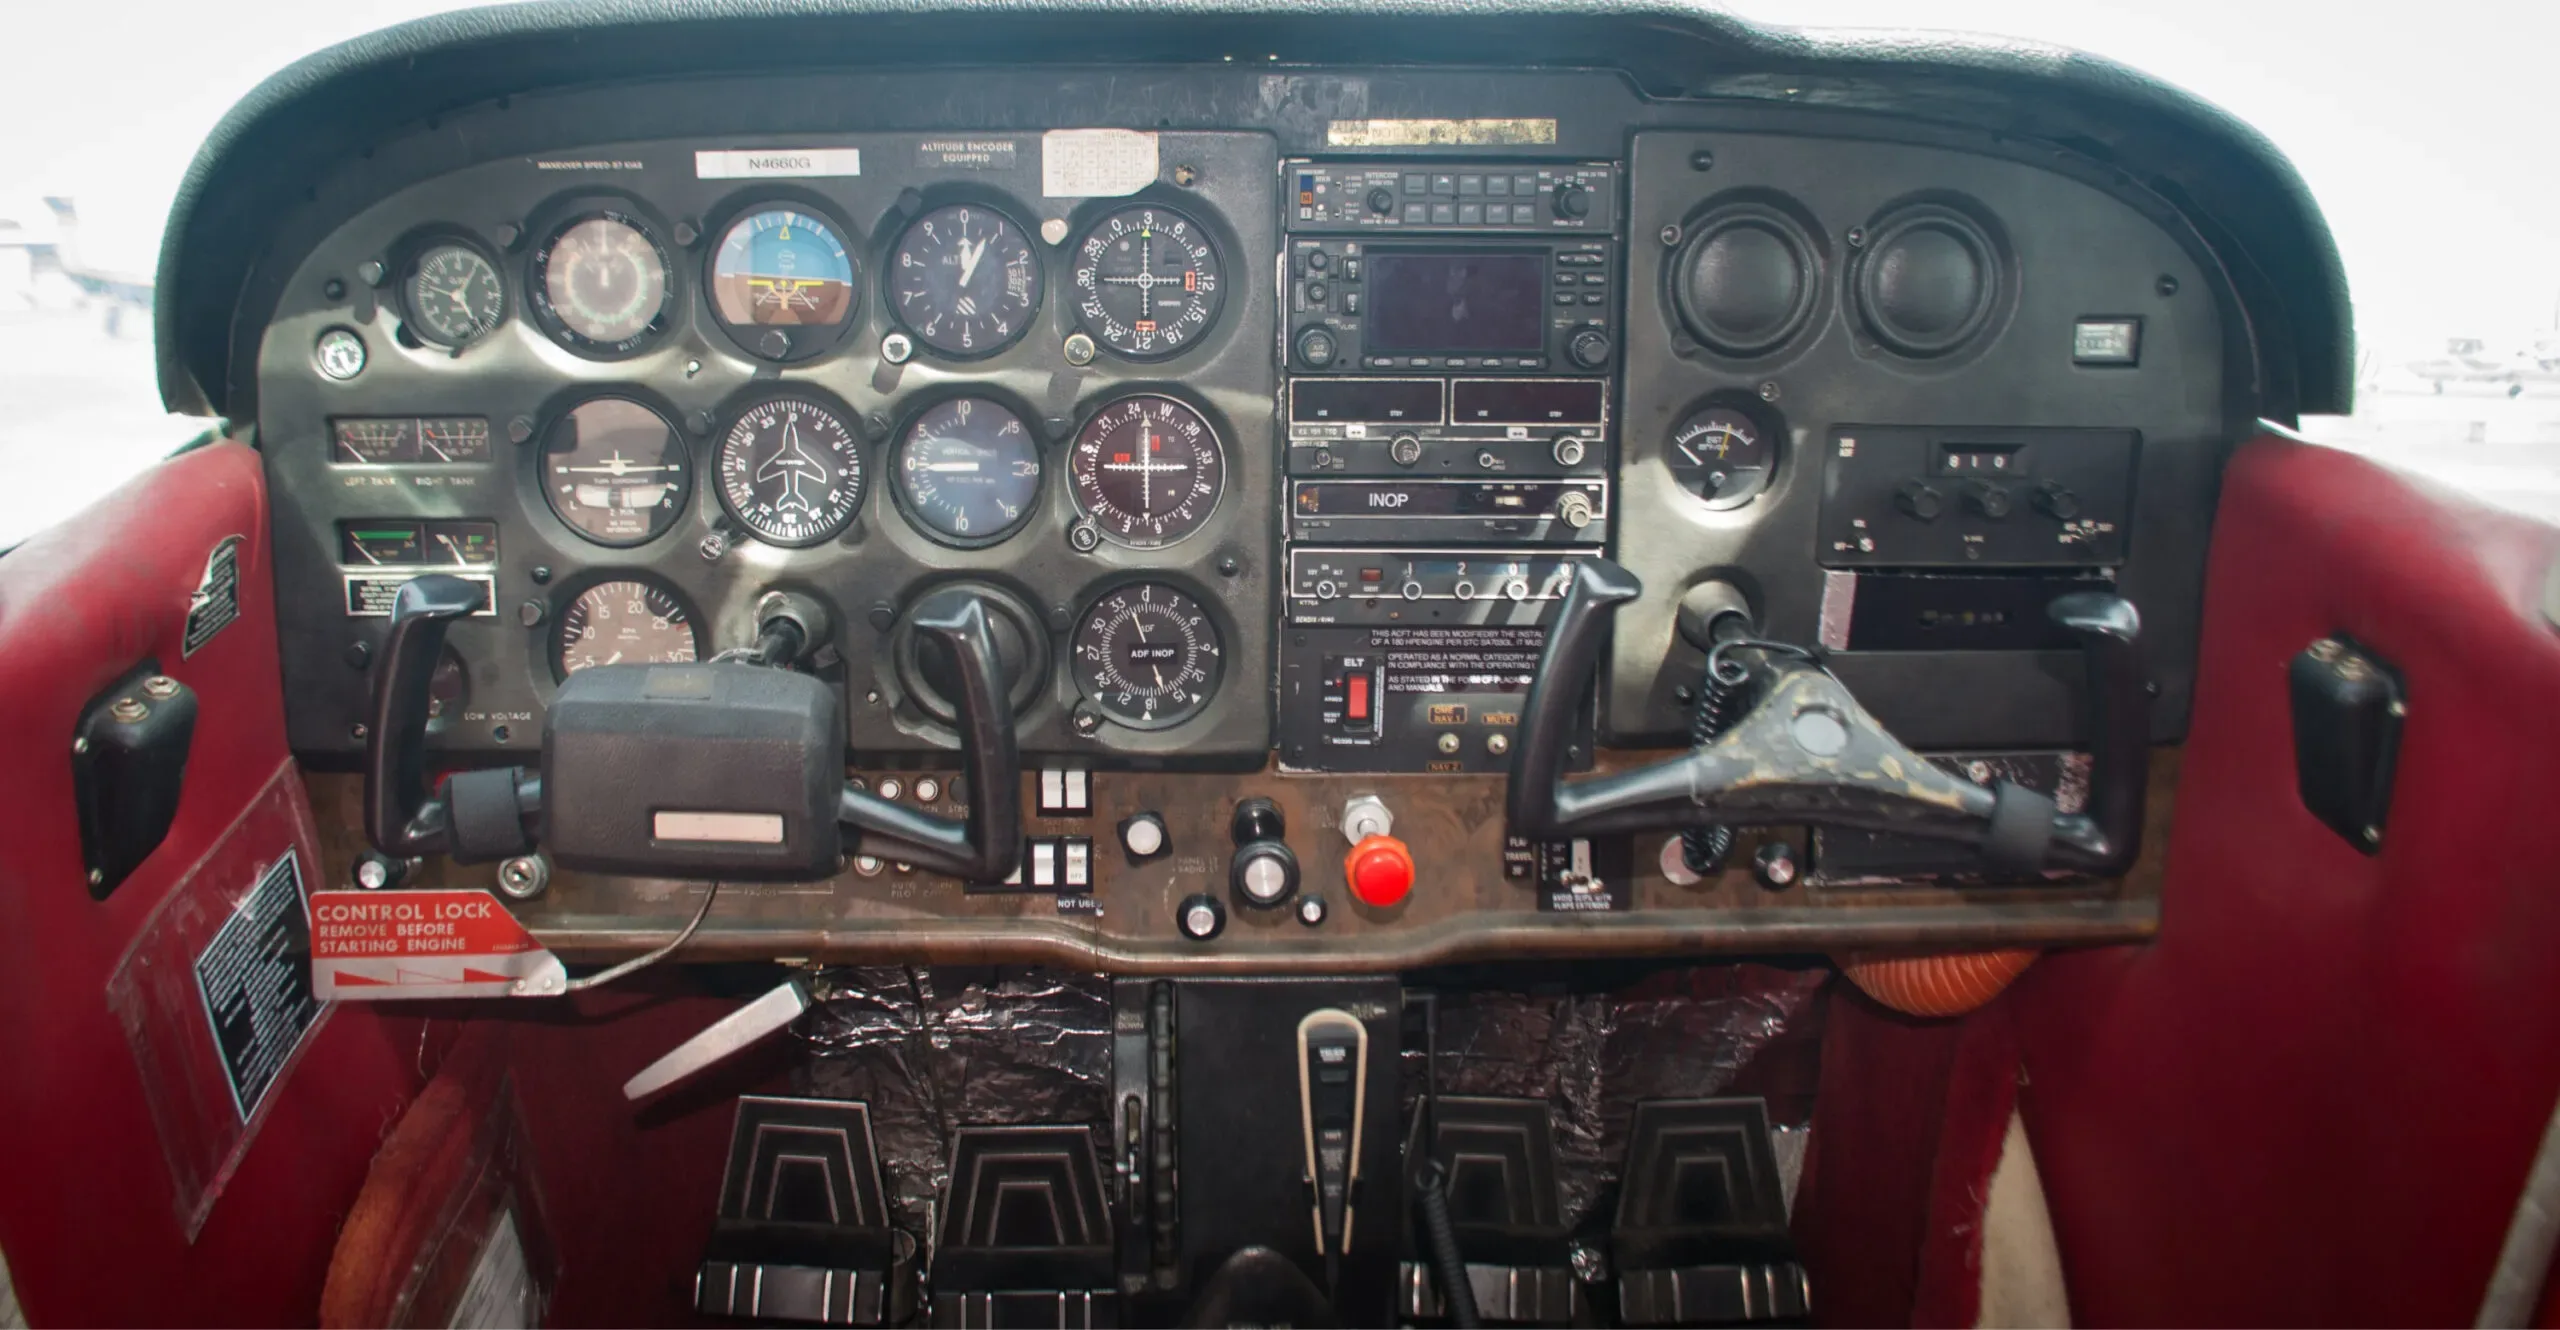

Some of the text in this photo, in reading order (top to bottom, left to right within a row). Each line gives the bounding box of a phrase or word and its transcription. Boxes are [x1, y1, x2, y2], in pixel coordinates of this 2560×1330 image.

[921, 143, 1014, 152] ALTITUDE ENCODER
[942, 154, 990, 163] EQUIPPED
[960, 209, 969, 224] 0
[1143, 212, 1153, 225] 3
[923, 222, 933, 236] 9
[1111, 219, 1122, 232] 0
[1174, 222, 1185, 235] 6
[1084, 238, 1101, 257] 33
[1195, 247, 1208, 258] 9
[902, 252, 912, 267] 8
[941, 256, 960, 265] ALT
[1019, 250, 1028, 265] 2
[1077, 269, 1090, 287] 30
[1202, 275, 1215, 291] 12
[904, 291, 913, 305] 7
[1020, 294, 1029, 308] 3
[1081, 301, 1099, 318] 27
[1191, 306, 1207, 323] 15
[926, 322, 936, 336] 6
[997, 322, 1008, 336] 4
[1103, 325, 1122, 342] 24
[963, 334, 972, 348] 5
[1166, 328, 1184, 345] 18
[1135, 337, 1152, 350] 21
[957, 401, 971, 414] 10
[1128, 402, 1141, 414] 24
[1160, 403, 1174, 417] W
[760, 416, 776, 429] 33
[814, 422, 824, 431] 3
[1007, 421, 1020, 433] 15
[1098, 416, 1111, 429] 21
[1185, 421, 1200, 436] 30
[918, 424, 927, 437] 5
[742, 432, 755, 446] 30
[832, 442, 843, 450] 6
[1081, 444, 1094, 454] S
[907, 457, 916, 470] 0
[1201, 450, 1213, 464] 33
[736, 457, 746, 472] 27
[1023, 463, 1039, 475] 20
[371, 477, 396, 486] TANK
[1079, 474, 1091, 487] 15
[741, 482, 754, 498] 24
[1198, 482, 1212, 495] N
[828, 489, 841, 503] 12
[918, 492, 927, 504] 5
[1369, 493, 1408, 507] INOP
[569, 501, 578, 511] L
[664, 498, 672, 509] R
[758, 503, 772, 516] 21
[1092, 501, 1106, 516] 12
[1005, 506, 1018, 518] 15
[1181, 509, 1192, 520] 3
[955, 518, 969, 531] 10
[1122, 520, 1132, 533] E
[1154, 521, 1162, 534] 6
[1457, 562, 1466, 575] 2
[1508, 562, 1518, 575] 0
[628, 602, 643, 614] 20
[1109, 596, 1126, 613] 33
[1170, 596, 1180, 607] 3
[599, 607, 610, 619] 15
[652, 617, 669, 630] 25
[1091, 619, 1106, 634] 30
[1190, 616, 1201, 626] 6
[583, 627, 595, 639] 10
[1372, 629, 1389, 637] THIS
[1391, 629, 1411, 637] ACFT
[1413, 629, 1429, 637] HAS
[1430, 629, 1450, 637] BEEN
[1501, 629, 1516, 637] THE
[1199, 643, 1211, 651] 9
[1371, 638, 1382, 646] OF
[1383, 638, 1390, 646] A
[1446, 638, 1462, 646] PER
[1463, 638, 1479, 646] STC
[1516, 638, 1524, 646] IT
[667, 652, 684, 663] 30
[1087, 645, 1099, 661] 27
[1131, 650, 1174, 658] ADF INOP
[1388, 653, 1429, 661] OPERATED
[1430, 653, 1441, 661] AS
[1442, 653, 1449, 661] A
[1450, 653, 1480, 661] NORMAL
[1483, 653, 1524, 661] CATEGORY
[585, 656, 595, 668] 5
[1344, 658, 1364, 667] ELT
[1094, 671, 1111, 688] 24
[1191, 668, 1206, 682] 12
[1388, 676, 1399, 684] AS
[1400, 676, 1430, 684] STATED
[1388, 684, 1404, 692] AND
[1117, 691, 1132, 706] 21
[1173, 688, 1187, 703] 15
[1144, 697, 1157, 710] 18
[464, 712, 531, 720] LOW VOLTAGE
[1431, 763, 1449, 771] NAV
[1504, 852, 1533, 861] TRAVEL
[1058, 899, 1075, 908] NOT
[1552, 894, 1572, 902] AVOID
[317, 902, 492, 922] CONTROL LOCK
[319, 923, 455, 938] REMOVE BEFORE
[319, 938, 465, 953] STARTING ENGINE
